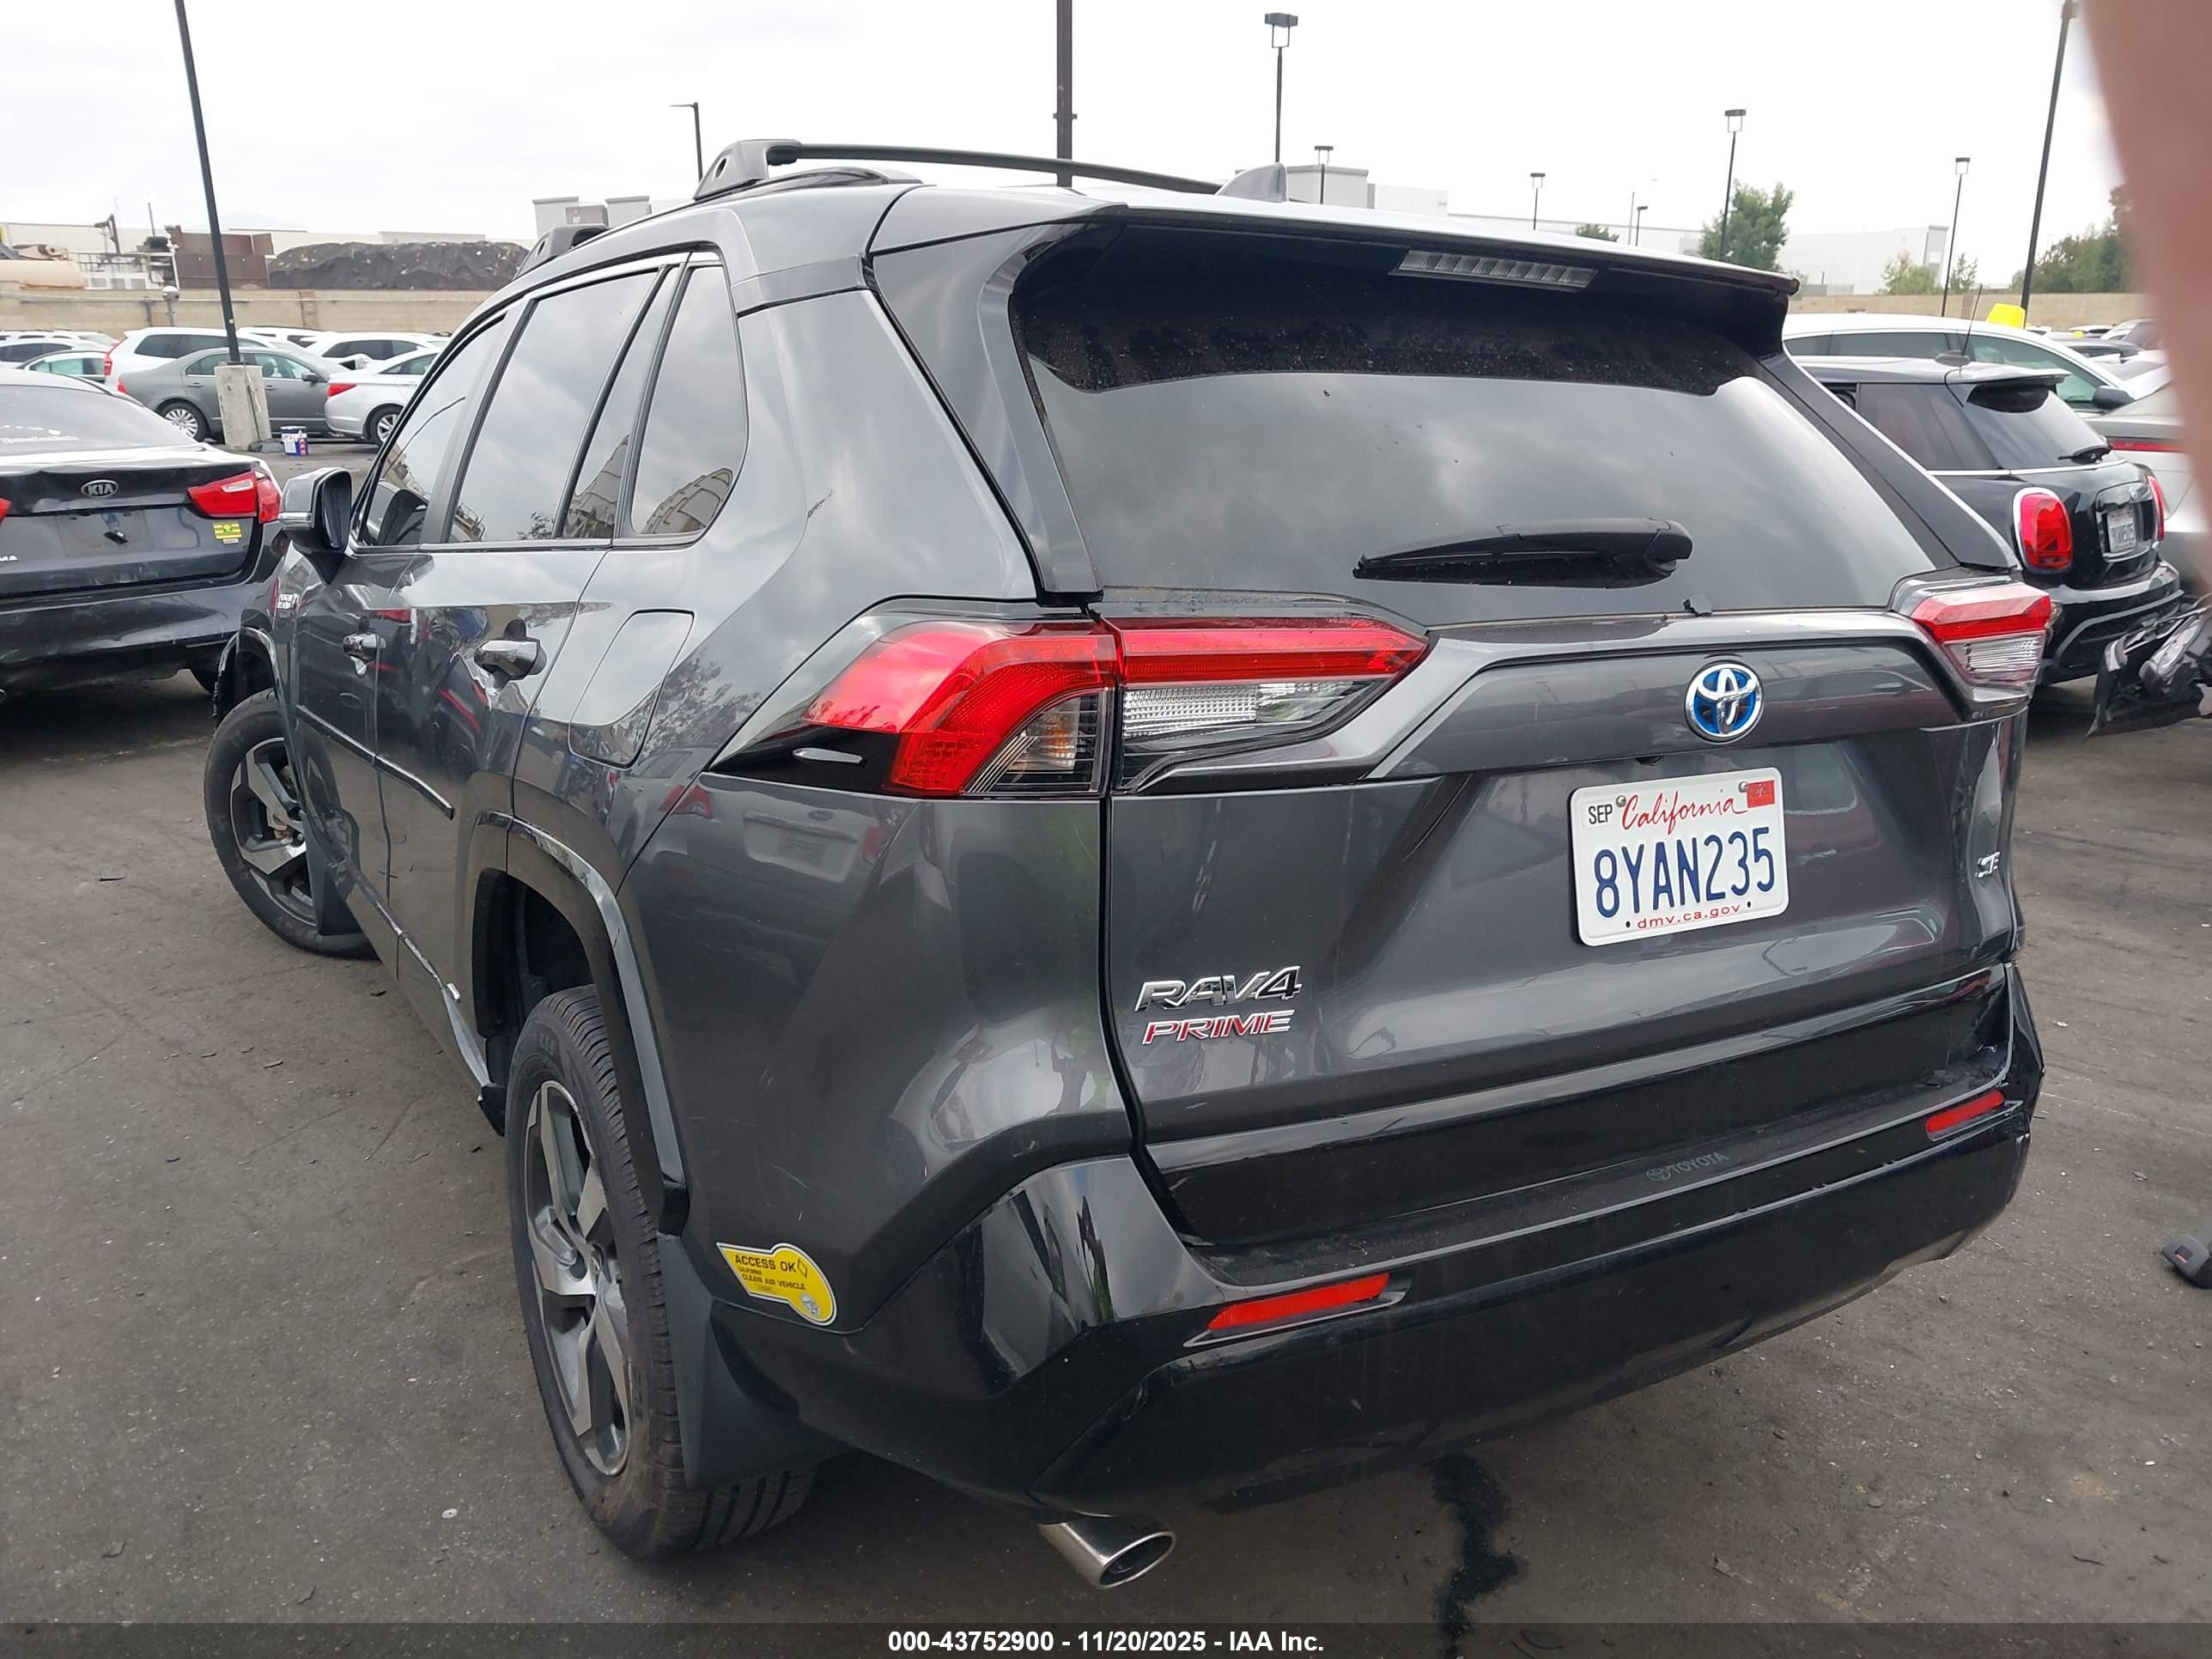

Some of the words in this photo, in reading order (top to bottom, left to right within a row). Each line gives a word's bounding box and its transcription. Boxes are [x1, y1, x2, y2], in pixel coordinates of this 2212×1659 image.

[87, 483, 114, 495] KIA
[1588, 803, 1613, 825] SEP
[1621, 790, 1748, 836] California
[1594, 826, 1776, 919] 8YAN235
[1637, 903, 1741, 929] dmv.ca.gov
[1133, 965, 1303, 1012] RAV4
[1142, 1010, 1296, 1045] PRIME
[1667, 1152, 1729, 1173] TOYOTA
[735, 1254, 776, 1270] ACCESS
[780, 1261, 797, 1273] OK
